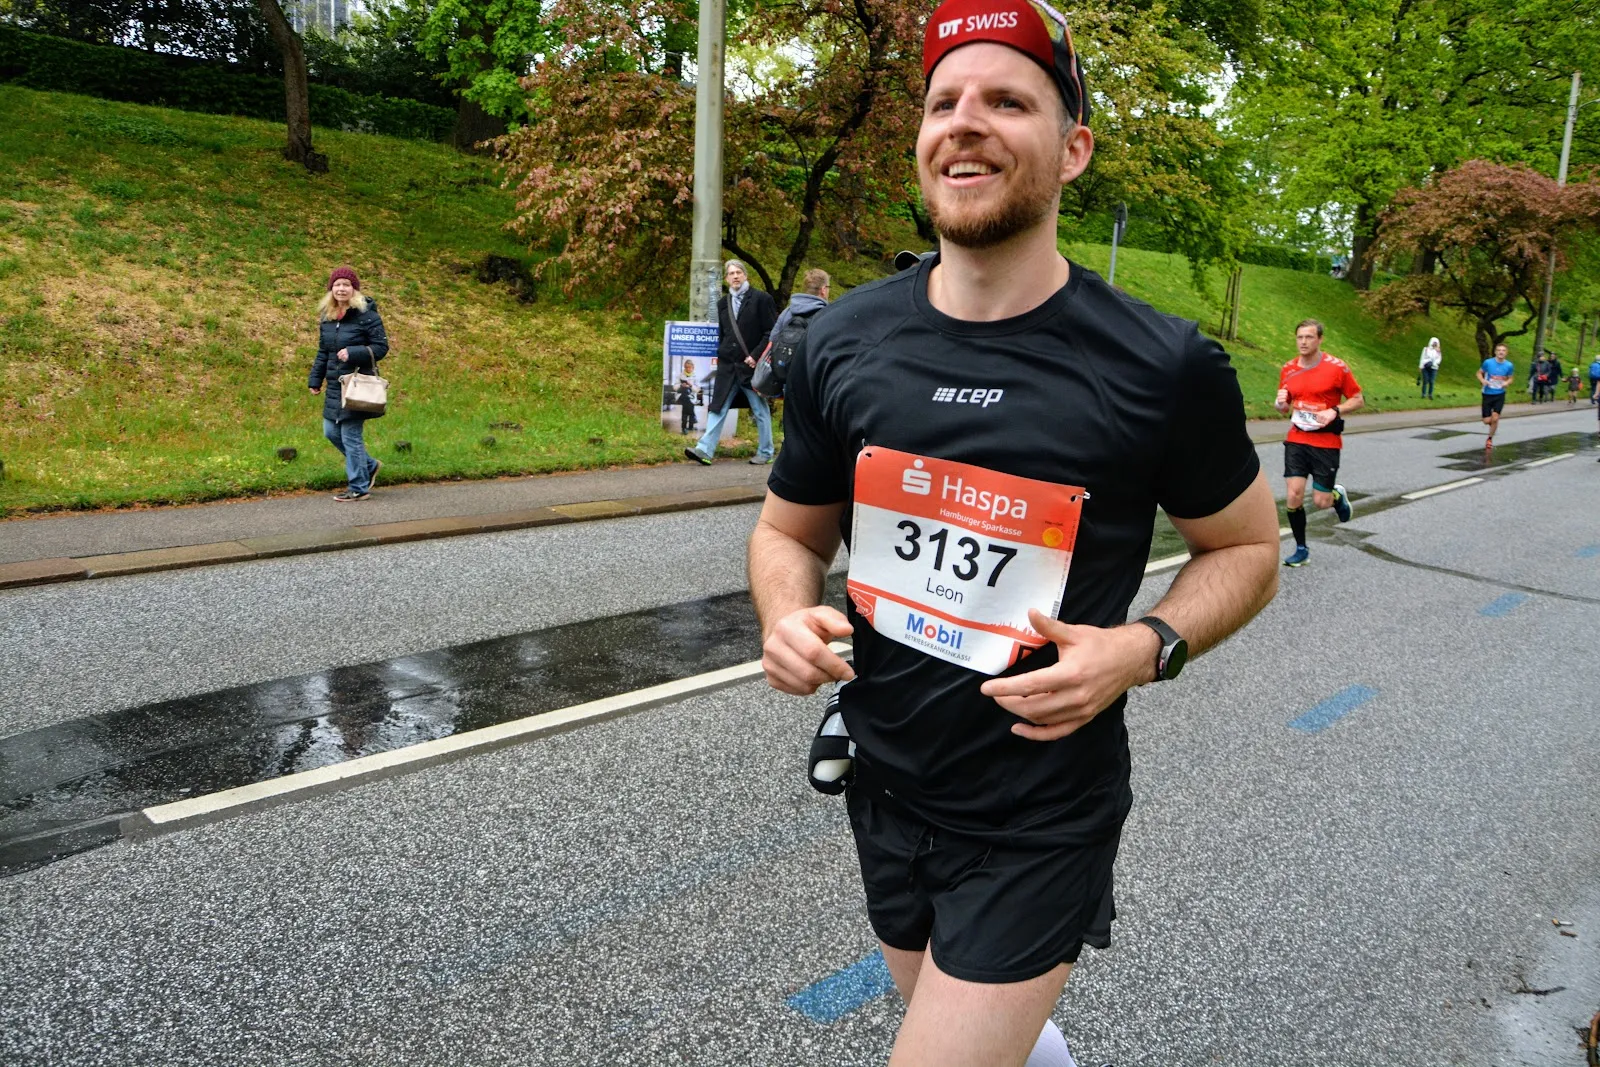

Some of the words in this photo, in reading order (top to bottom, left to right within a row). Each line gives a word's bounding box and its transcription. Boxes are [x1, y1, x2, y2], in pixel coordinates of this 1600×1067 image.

[938, 18, 963, 39] DT
[966, 12, 1018, 32] SWISS
[956, 388, 1004, 408] cep
[941, 475, 1028, 520] Haspa
[940, 508, 981, 529] Hamburger
[981, 519, 1023, 537] Sparkasse
[894, 520, 1018, 588] 3137
[926, 577, 964, 604] Leon
[906, 612, 963, 650] Mobil
[904, 633, 971, 662] BETRIEBSKRANKENKASSE
